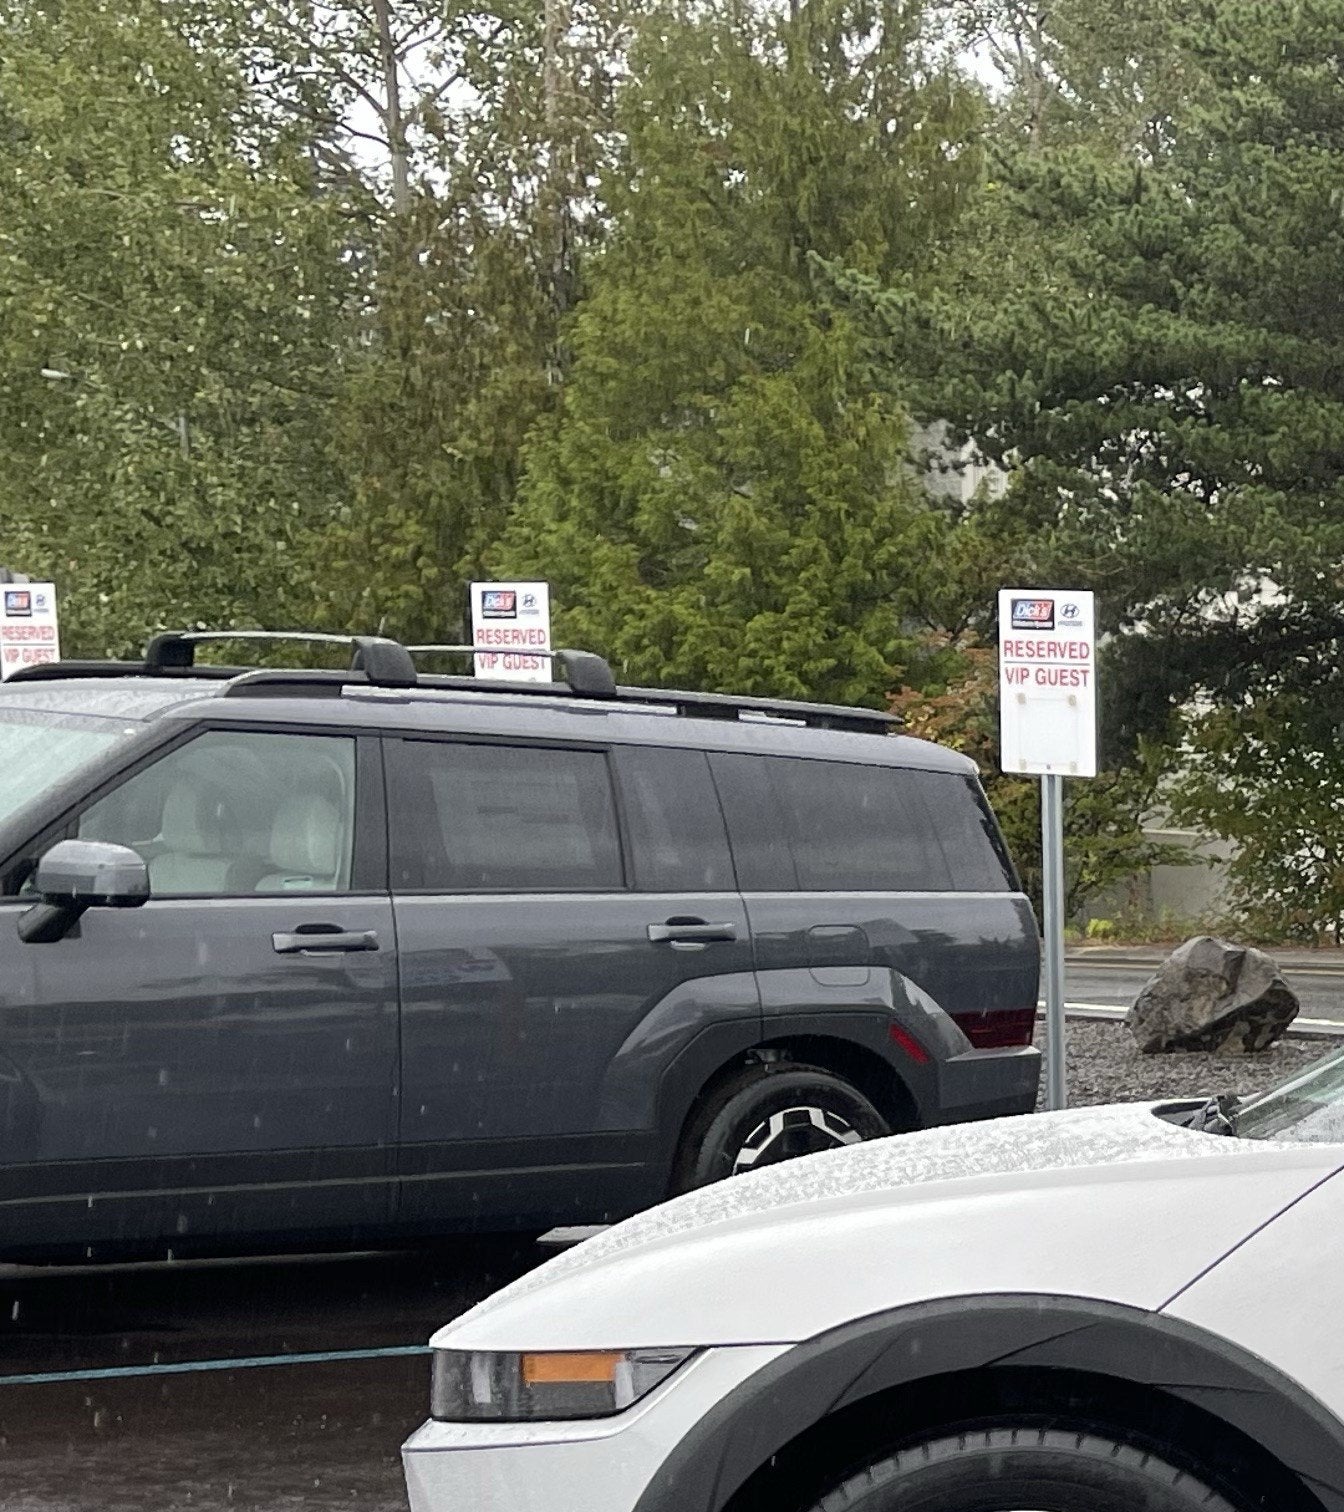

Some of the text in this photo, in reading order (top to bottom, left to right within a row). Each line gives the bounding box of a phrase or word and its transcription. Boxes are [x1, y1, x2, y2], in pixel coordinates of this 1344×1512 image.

[476, 628, 546, 645] RESERVED
[1003, 640, 1090, 659] RESERVED
[1005, 668, 1090, 687] VIP GUEST
